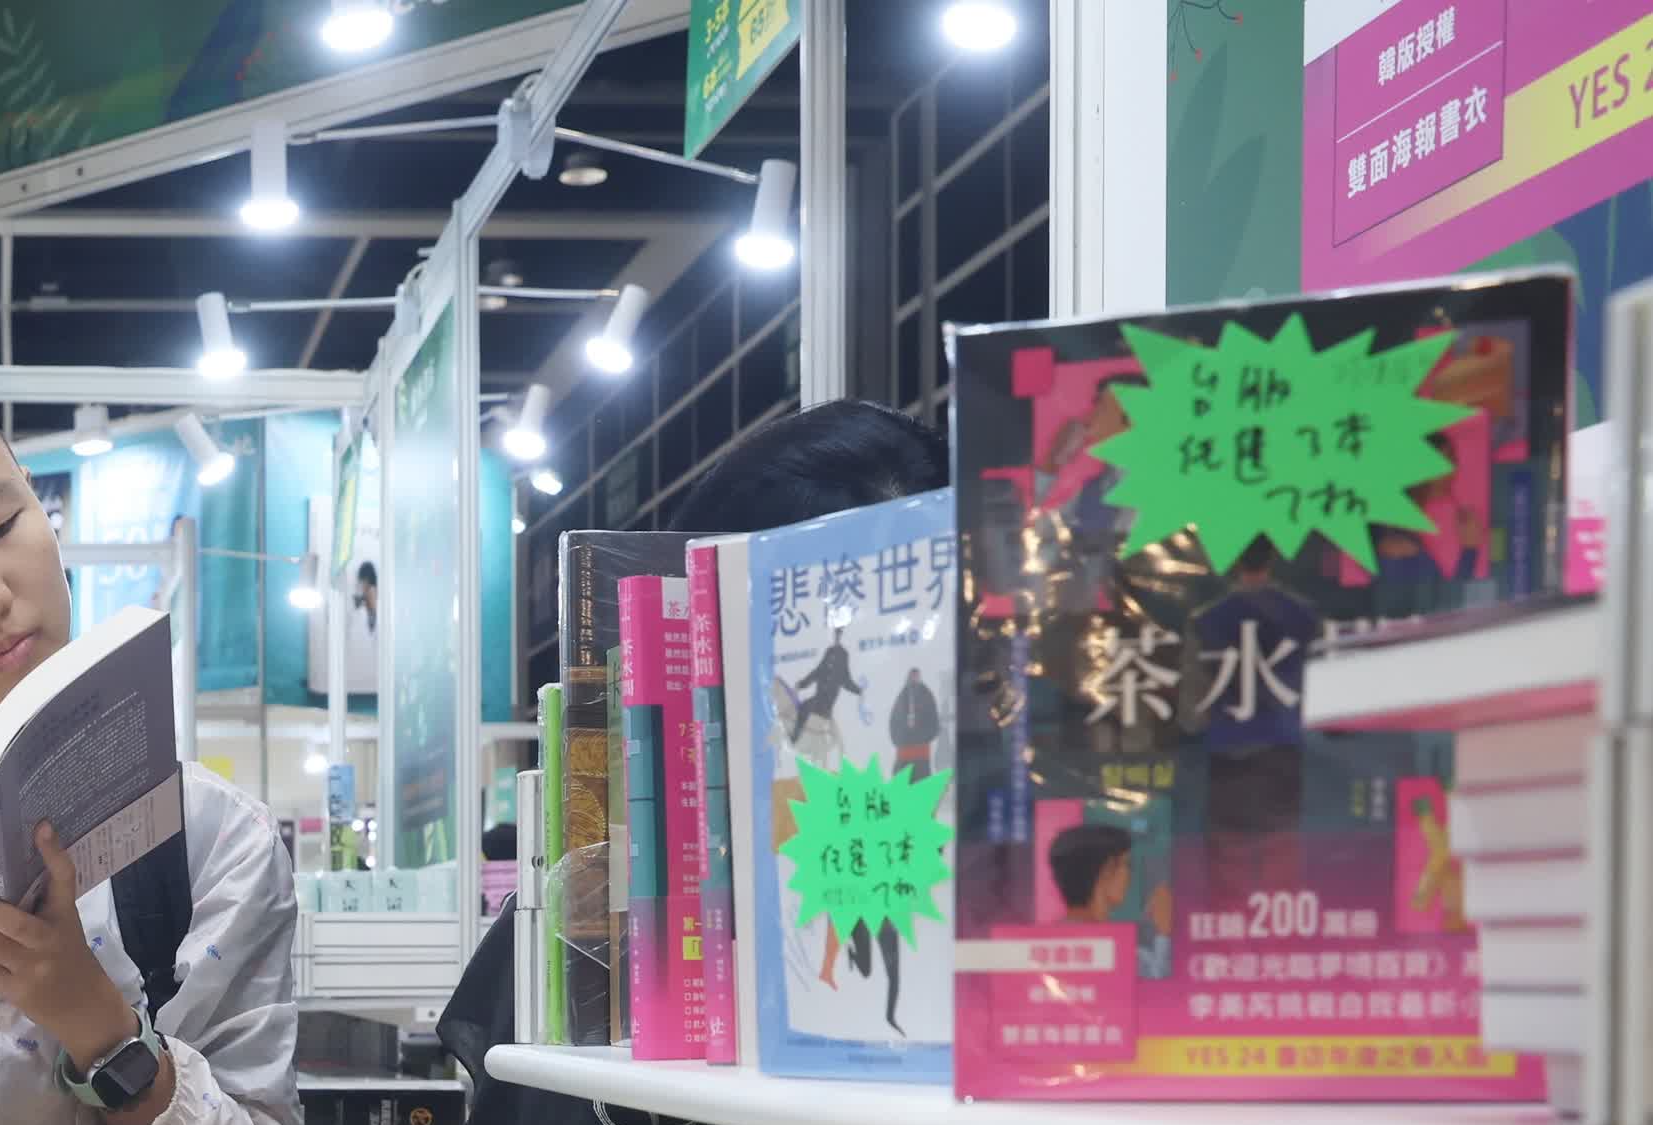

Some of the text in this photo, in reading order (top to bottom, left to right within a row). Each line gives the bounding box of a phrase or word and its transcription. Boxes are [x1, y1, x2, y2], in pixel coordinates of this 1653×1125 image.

[1377, 6, 1456, 86] 韓版授權
[1569, 53, 1631, 129] YES
[1347, 86, 1488, 199] 雙面海報書衣
[771, 536, 955, 637] 悲慘世界
[1084, 615, 1382, 728] 茶水
